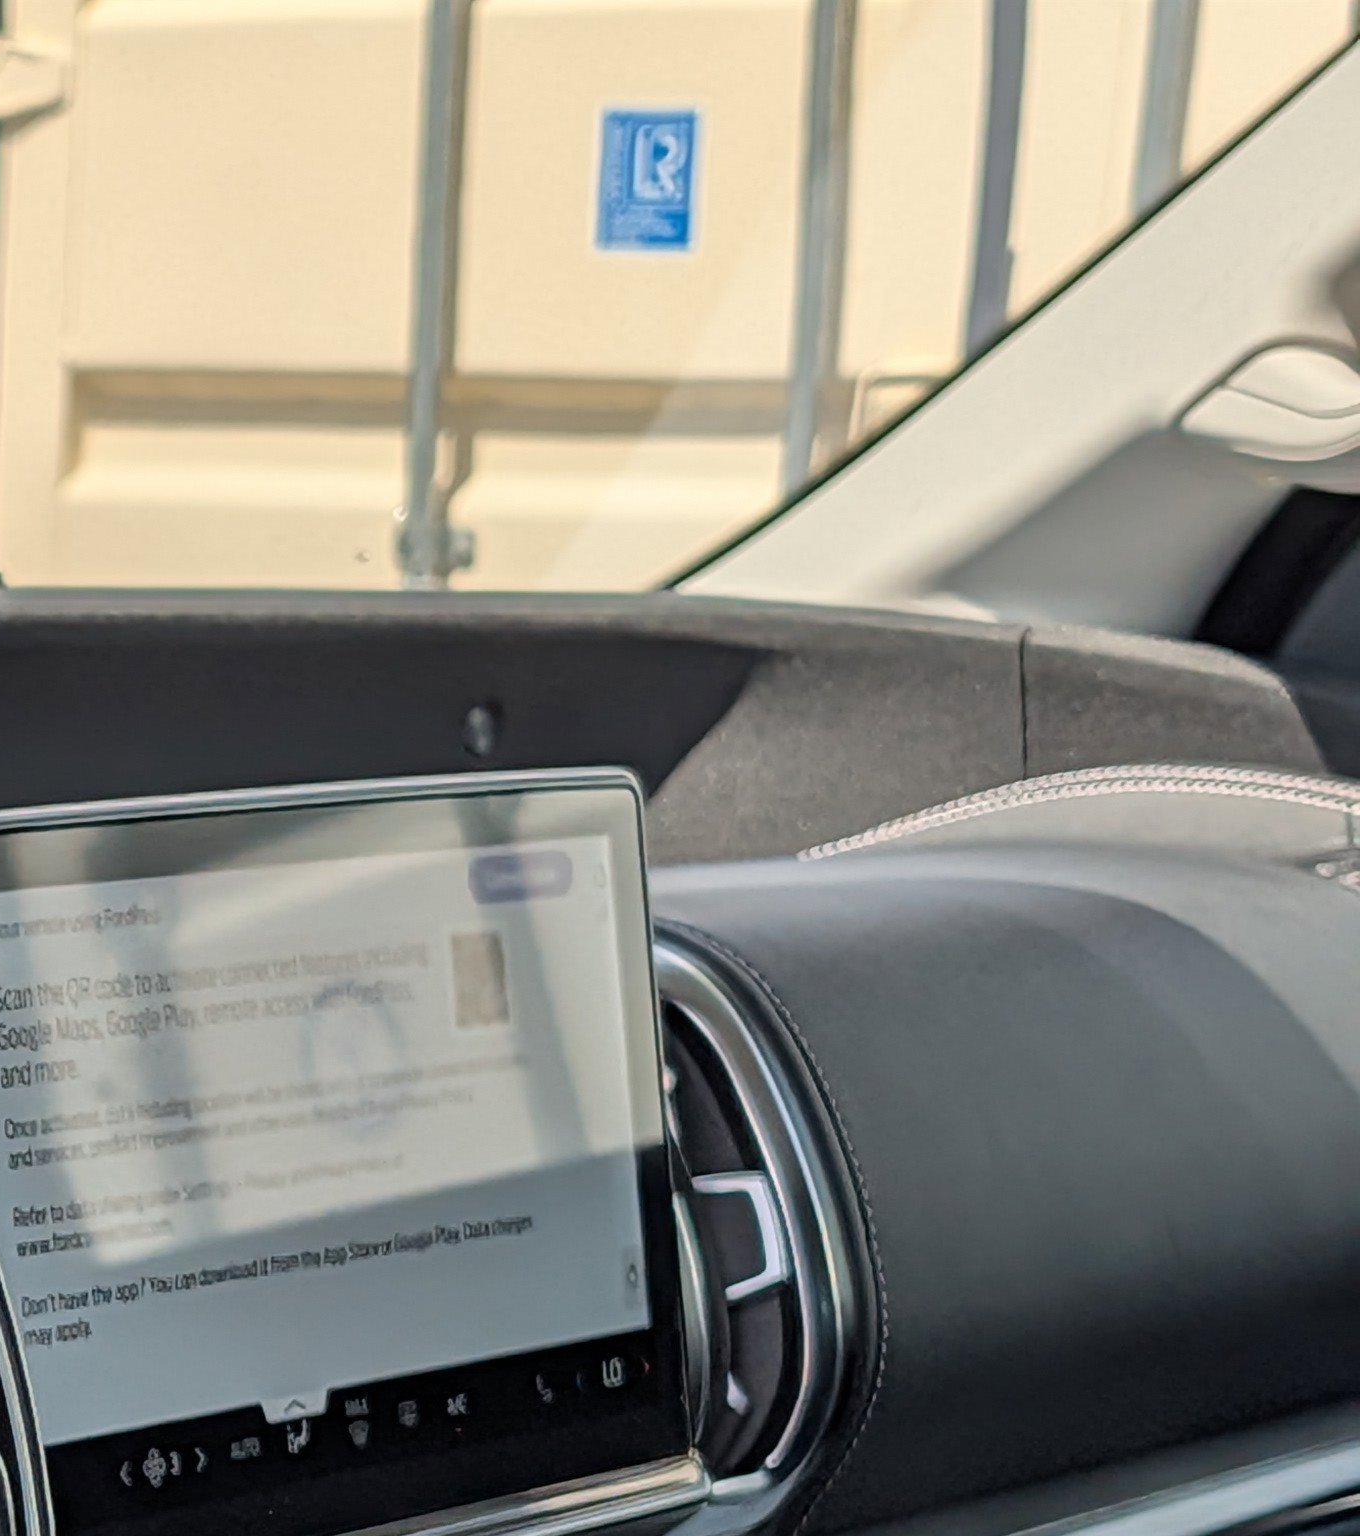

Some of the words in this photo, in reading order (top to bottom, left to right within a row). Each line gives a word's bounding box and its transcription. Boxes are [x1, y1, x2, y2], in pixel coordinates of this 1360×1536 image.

[106, 1006, 161, 1037] Google
[0, 1062, 32, 1089] and
[21, 1294, 56, 1318] Don't
